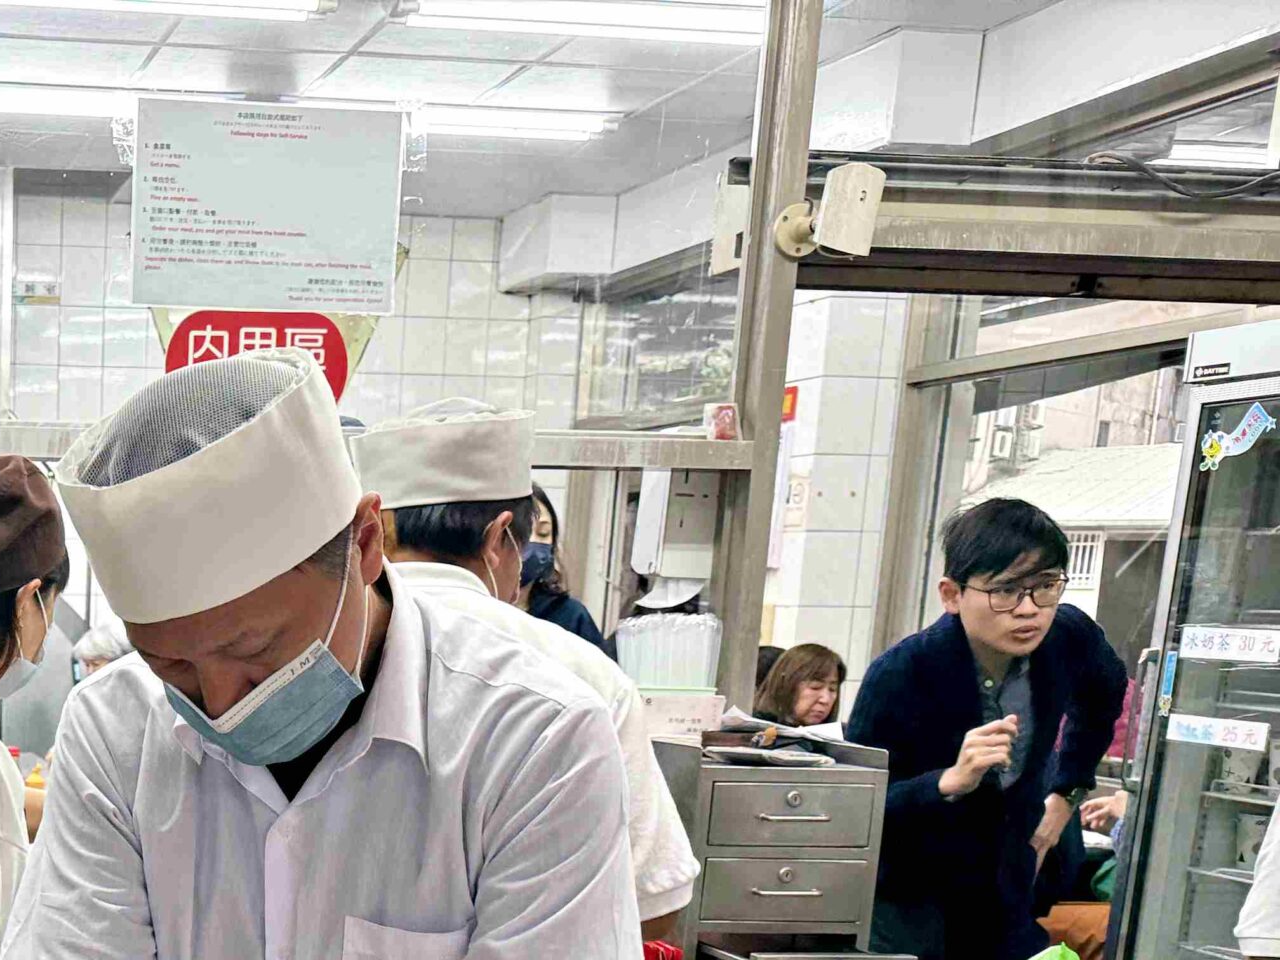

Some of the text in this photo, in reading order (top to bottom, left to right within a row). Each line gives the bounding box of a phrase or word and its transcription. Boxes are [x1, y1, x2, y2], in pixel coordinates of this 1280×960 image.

[1238, 635, 1256, 652] 30
[1259, 637, 1276, 653] 元
[1221, 725, 1239, 743] 25
[1242, 728, 1258, 745] 元
